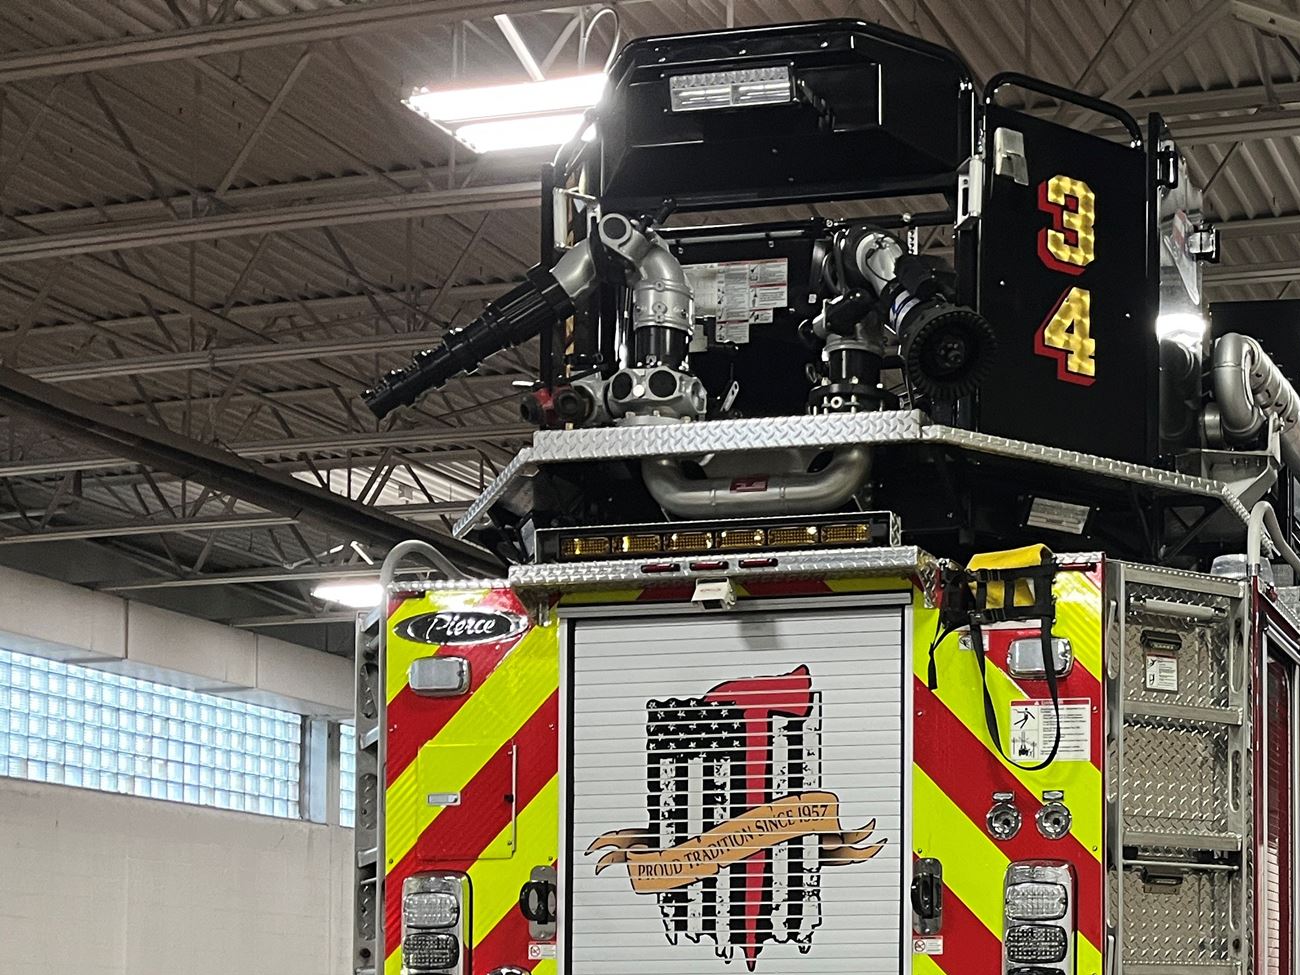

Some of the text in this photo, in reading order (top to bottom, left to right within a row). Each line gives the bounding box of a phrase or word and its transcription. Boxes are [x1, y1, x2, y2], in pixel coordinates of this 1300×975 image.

[426, 613, 496, 640] Pierce
[638, 804, 829, 880] PROUD TRADITION SINCE 1957
